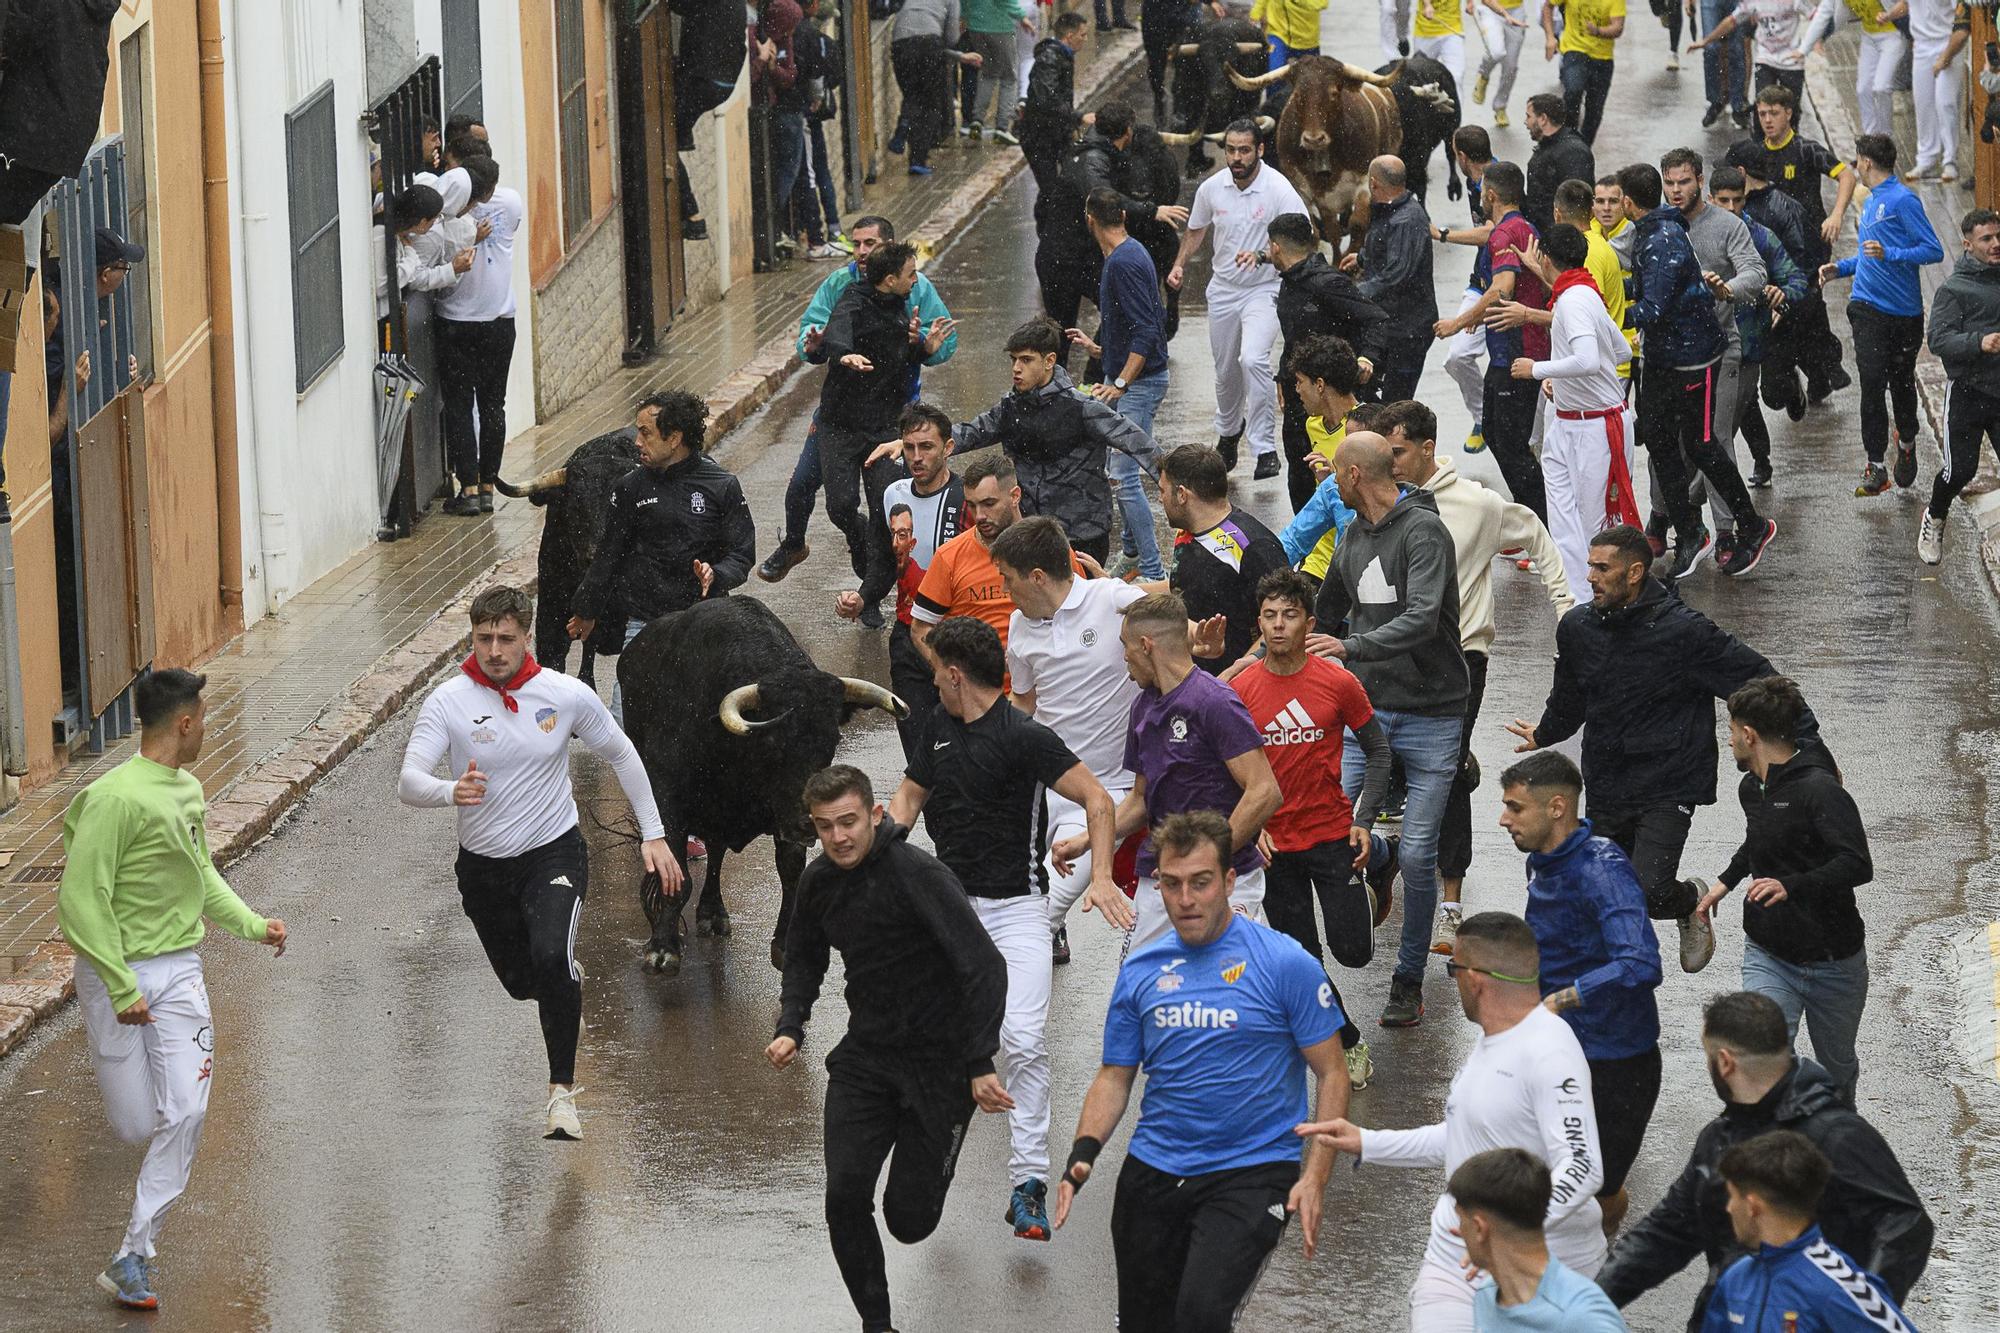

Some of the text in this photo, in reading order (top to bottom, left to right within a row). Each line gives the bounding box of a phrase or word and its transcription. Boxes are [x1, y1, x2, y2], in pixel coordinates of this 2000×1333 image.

[968, 584, 1010, 601] ME
[1263, 727, 1324, 746] adidas
[1154, 1001, 1238, 1029] satine
[1564, 1117, 1593, 1184] RUNING
